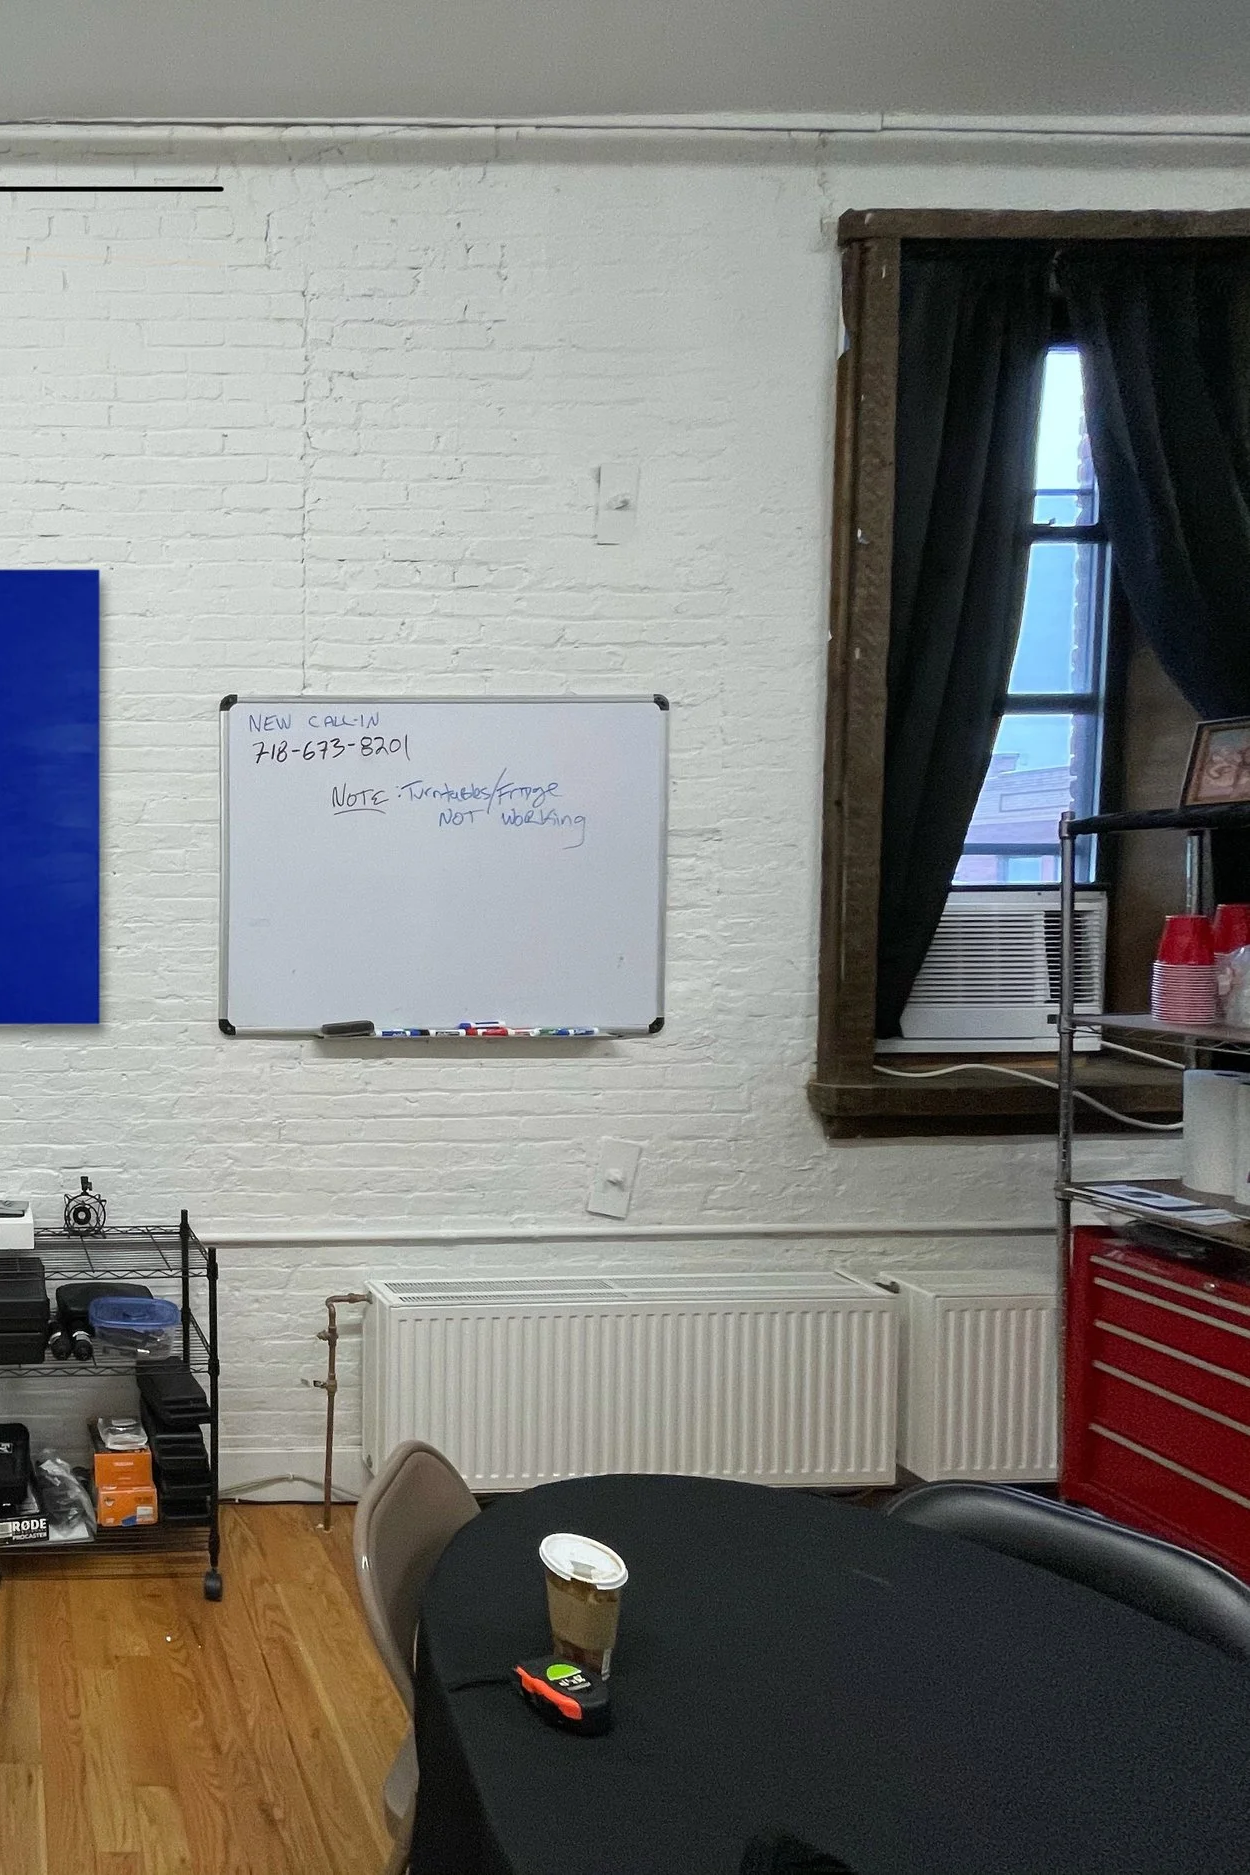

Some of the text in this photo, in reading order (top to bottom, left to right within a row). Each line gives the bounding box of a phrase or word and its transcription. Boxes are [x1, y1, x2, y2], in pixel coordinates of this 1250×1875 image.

[248, 711, 380, 733] NEW CALL-IN
[252, 733, 411, 765] 718-673-8201
[438, 808, 486, 827] NOT
